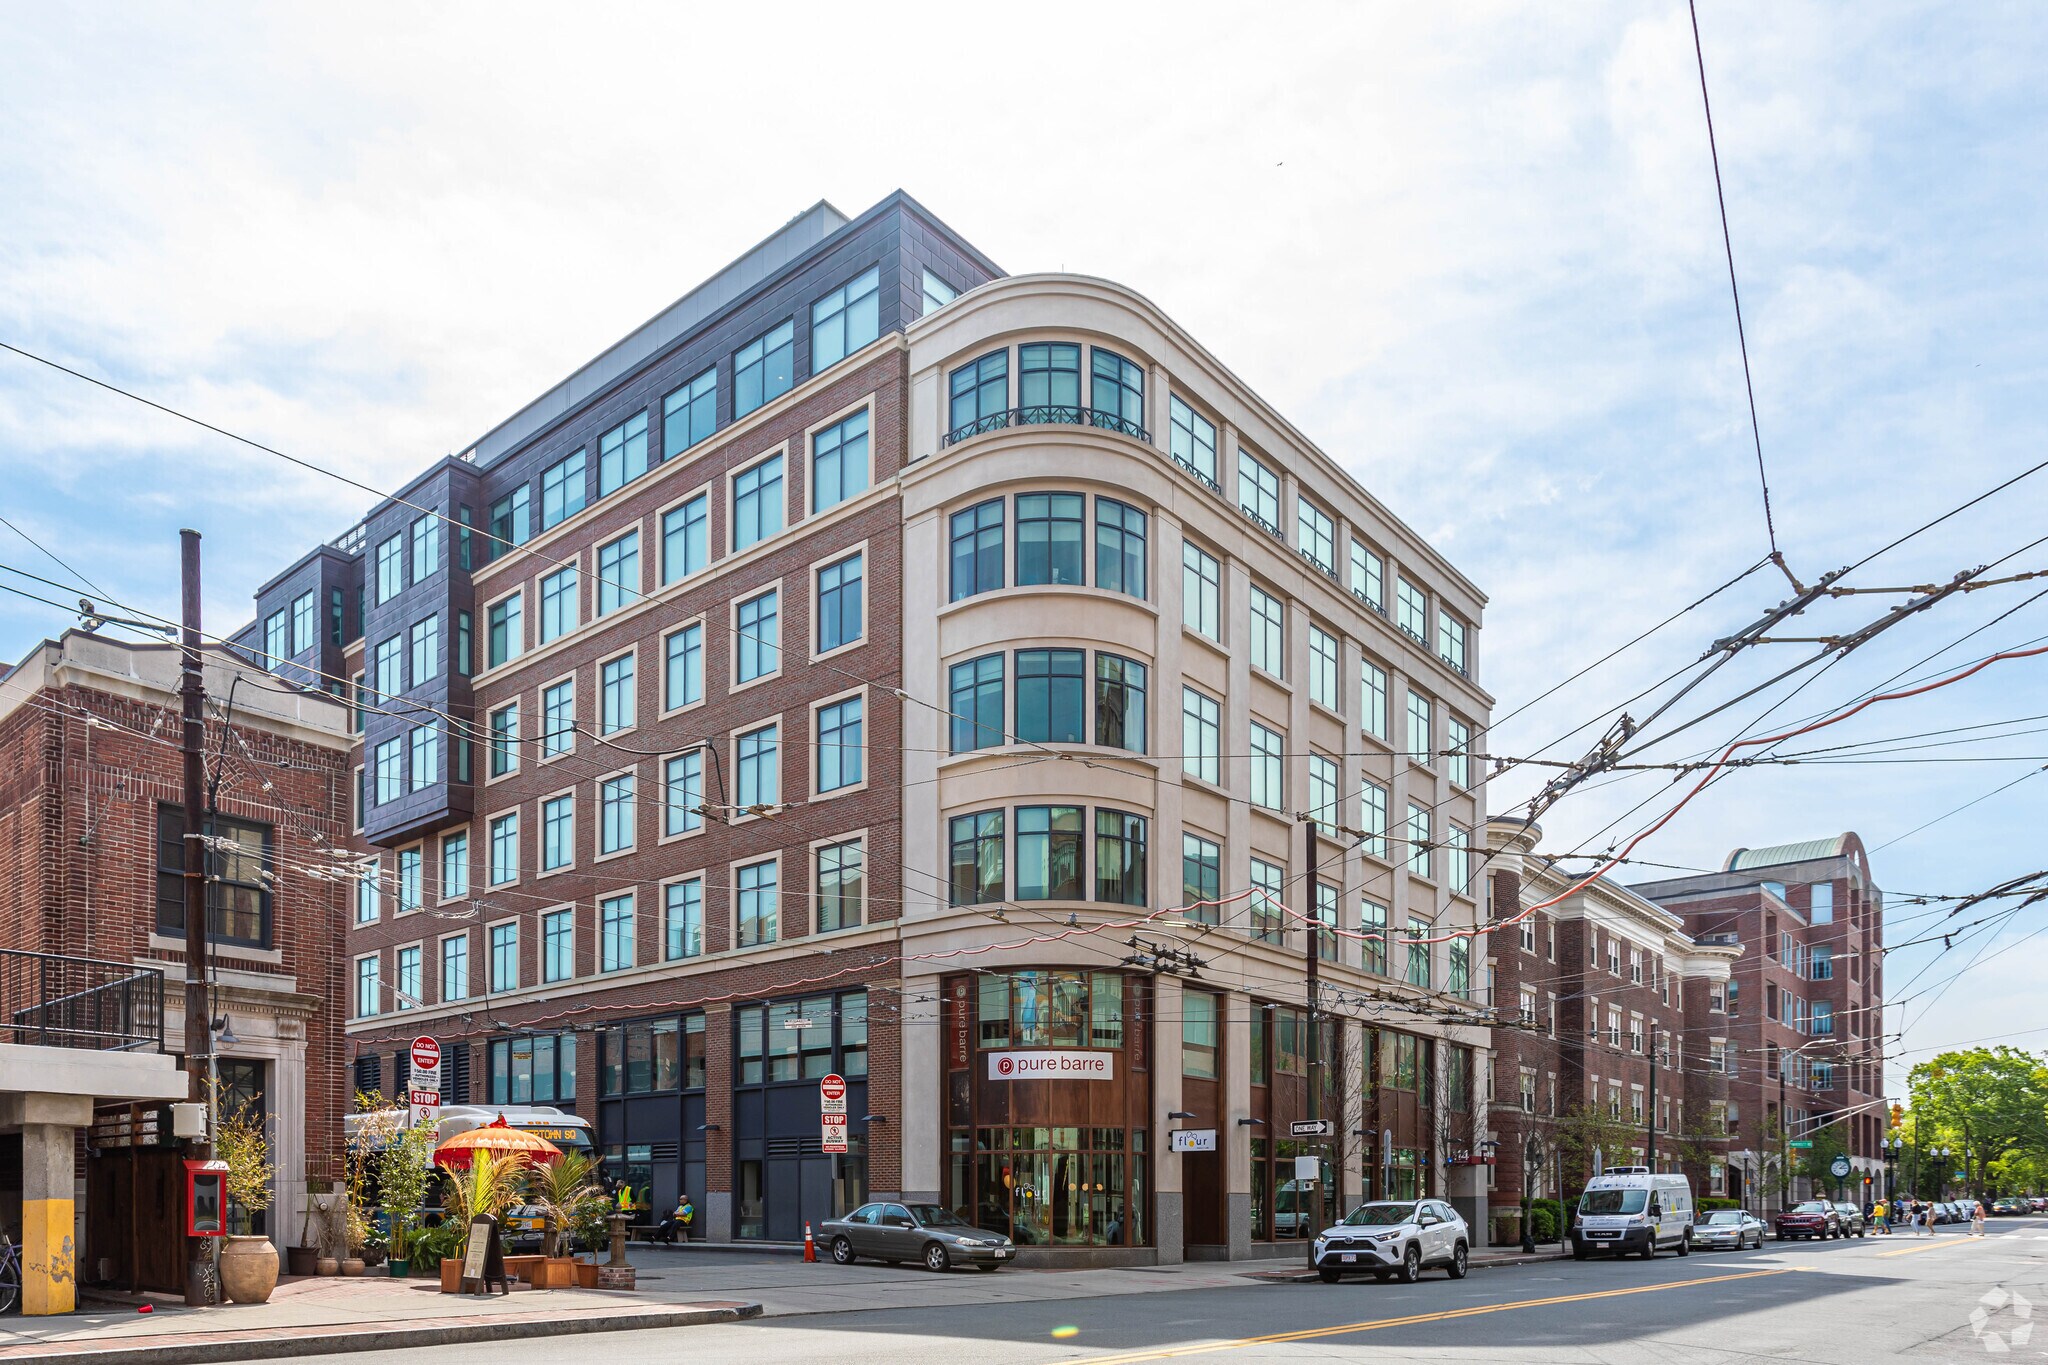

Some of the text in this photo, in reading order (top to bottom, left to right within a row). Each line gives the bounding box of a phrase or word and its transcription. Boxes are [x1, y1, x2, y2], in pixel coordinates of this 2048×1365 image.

[957, 1000, 966, 1028] pure
[958, 1030, 968, 1063] barre
[417, 1057, 435, 1065] ENTER
[1018, 1058, 1057, 1074] pure
[1060, 1056, 1104, 1071] barre
[413, 1092, 437, 1105] STOP
[824, 1116, 844, 1124] STOP
[564, 1129, 577, 1140] SQ
